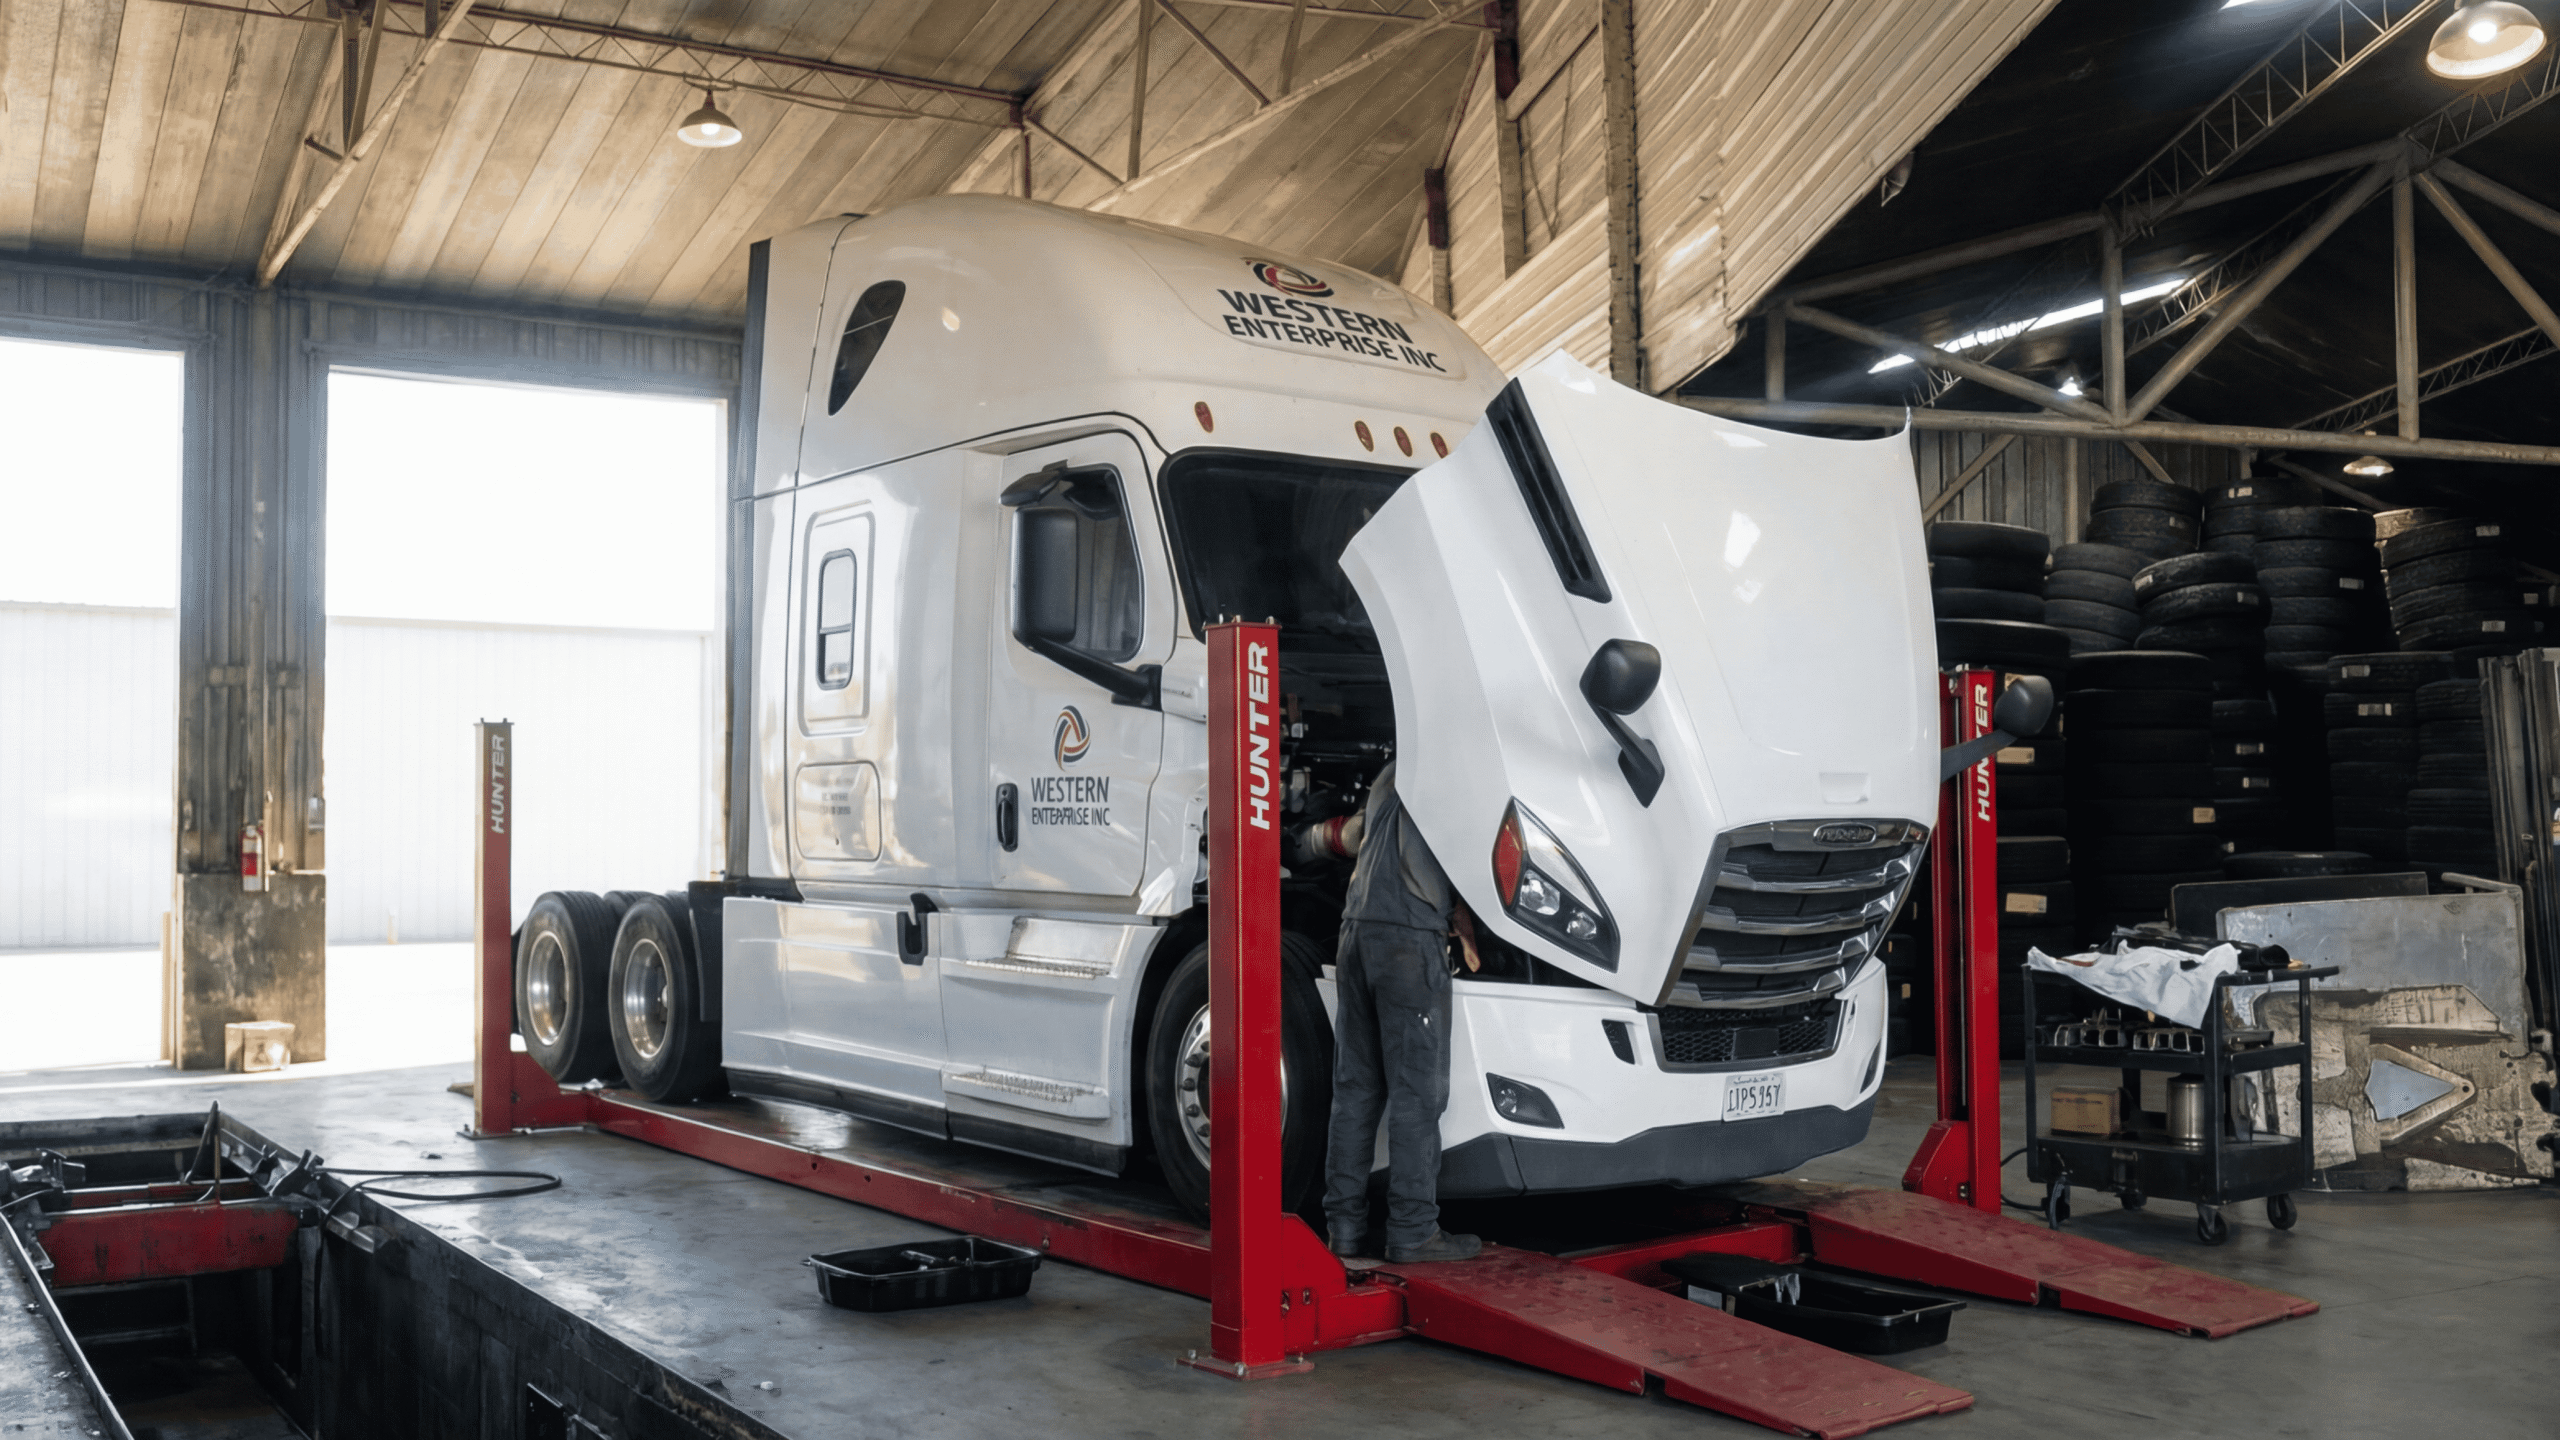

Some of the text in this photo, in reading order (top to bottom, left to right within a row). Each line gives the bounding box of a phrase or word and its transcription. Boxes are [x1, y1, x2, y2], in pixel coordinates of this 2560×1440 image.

[1217, 289, 1413, 344] WESTERN
[1223, 314, 1447, 372] ENTERPRISE INC
[1248, 641, 1270, 830] HUNTER
[1975, 684, 1990, 822] HUNER
[491, 734, 505, 834] HUNTER
[1031, 776, 1110, 803] WESTERN
[1092, 807, 1110, 826] INC
